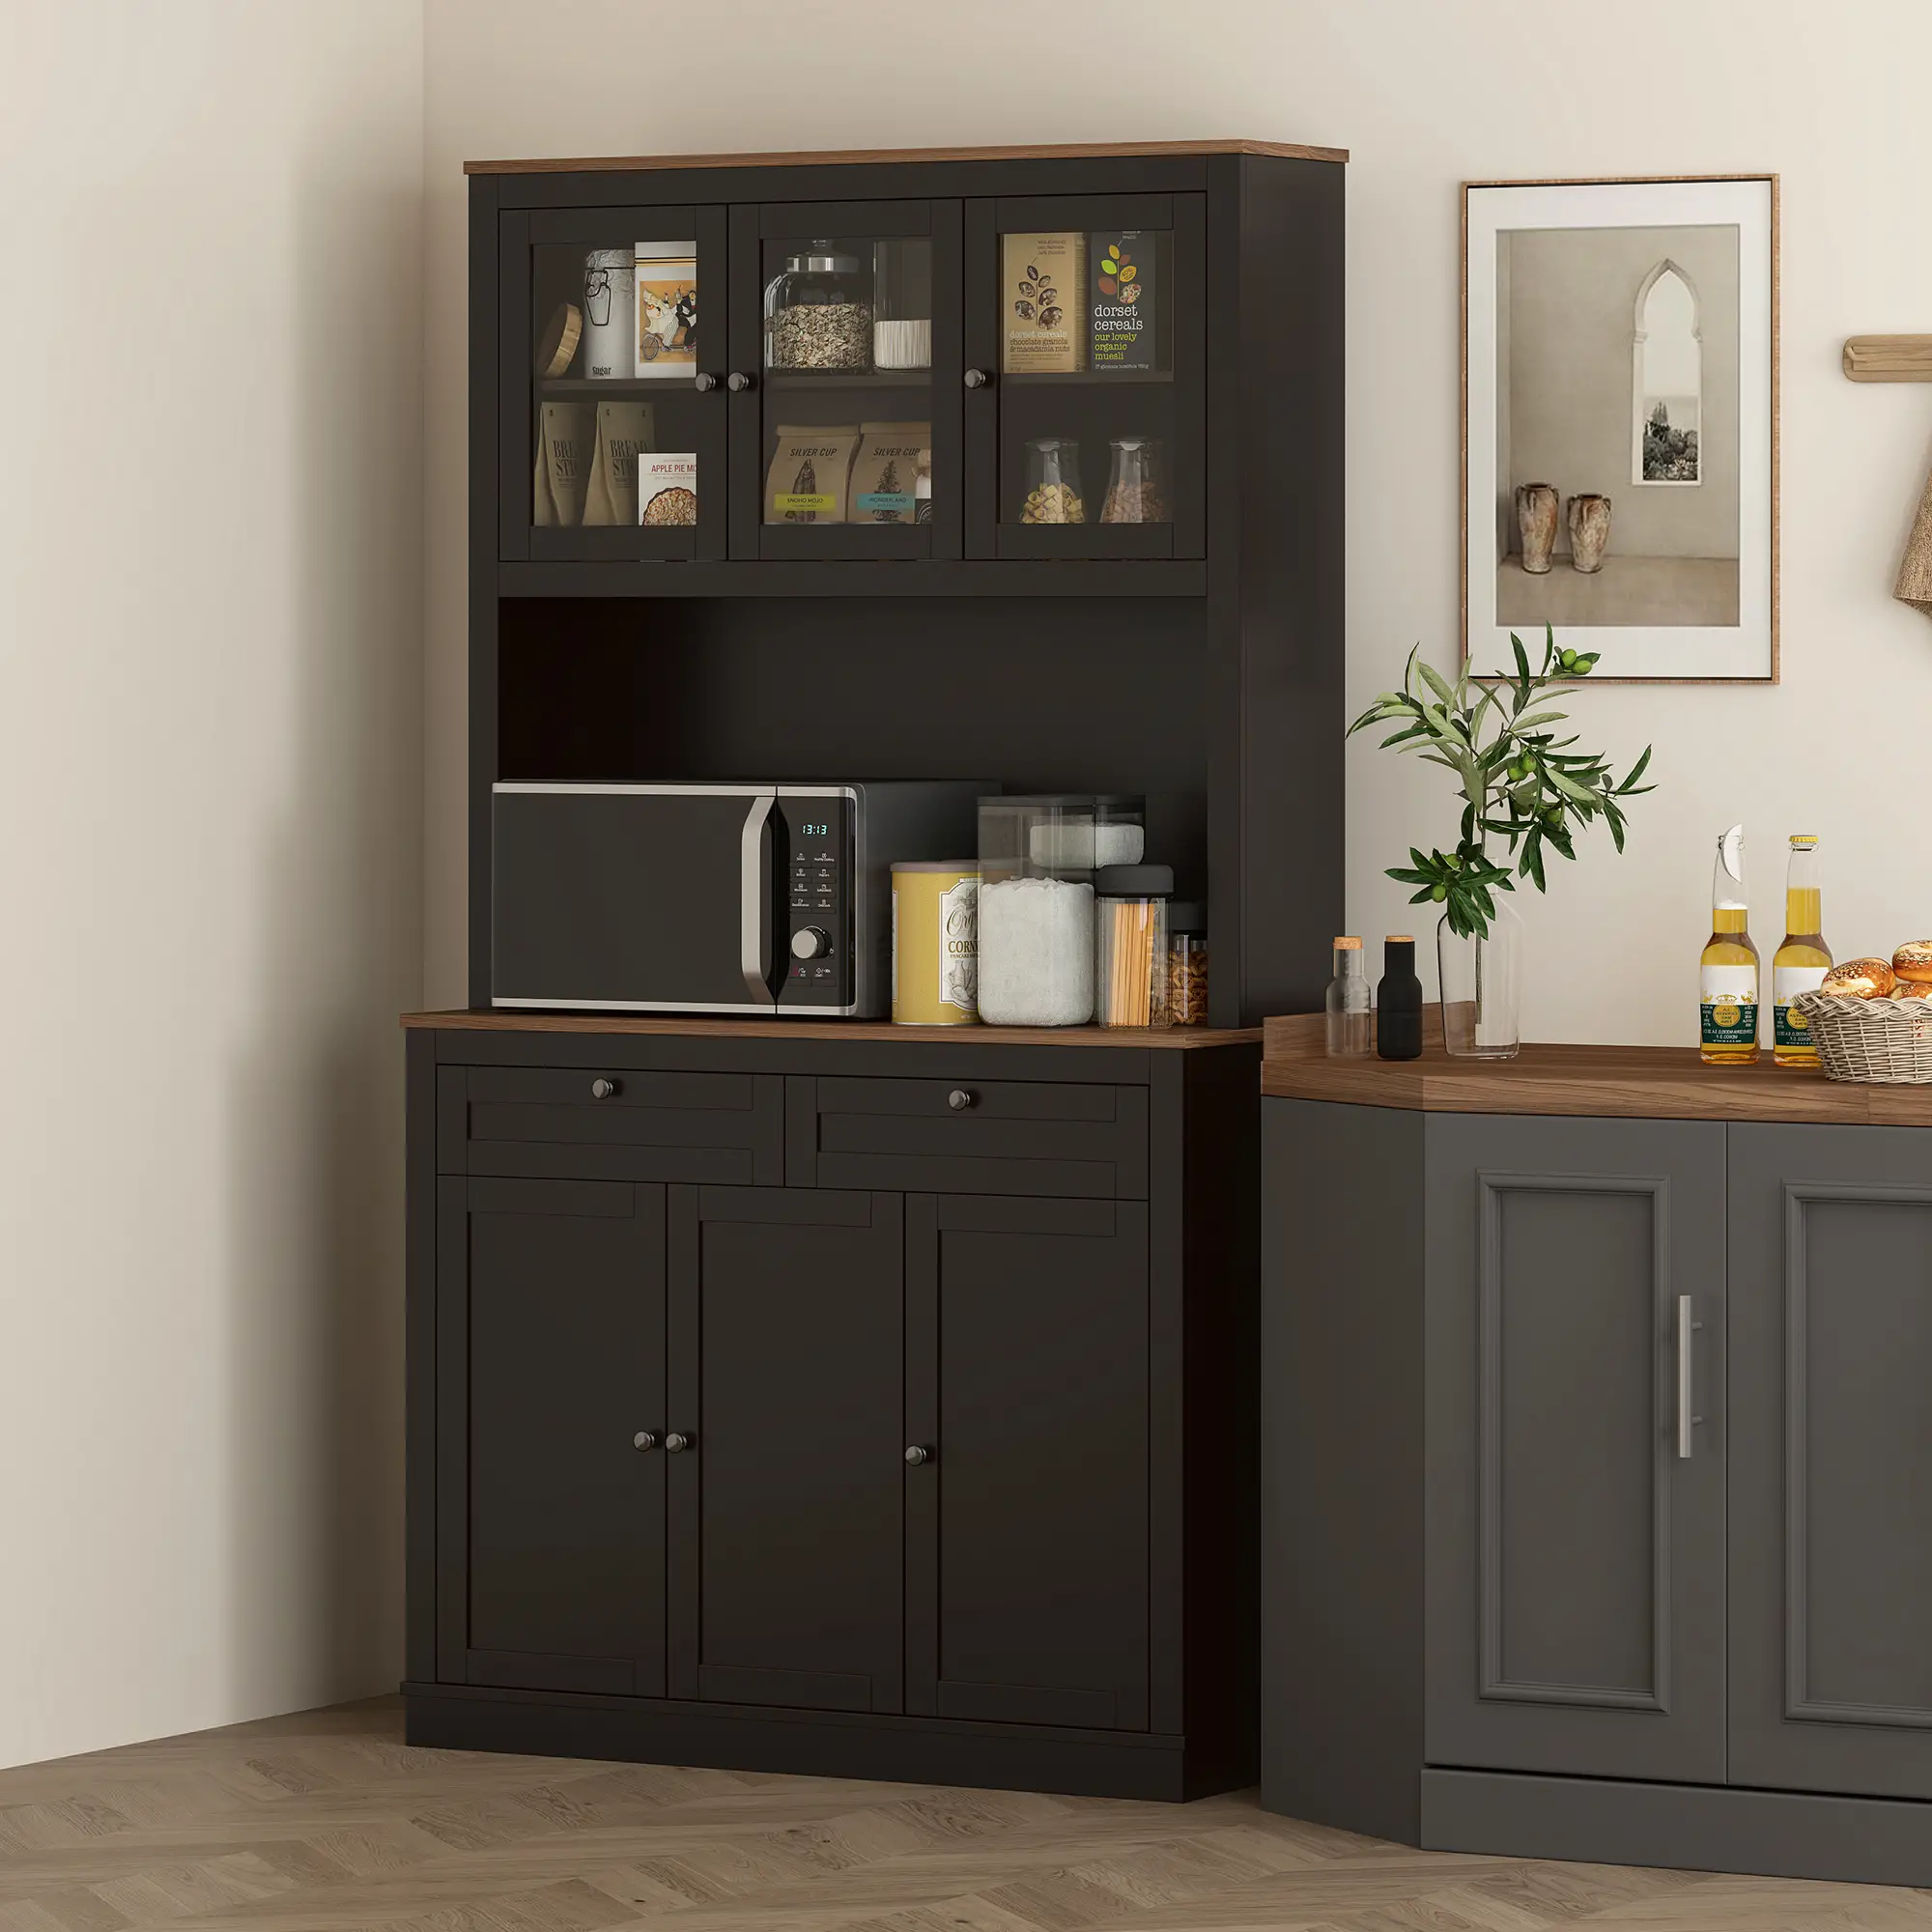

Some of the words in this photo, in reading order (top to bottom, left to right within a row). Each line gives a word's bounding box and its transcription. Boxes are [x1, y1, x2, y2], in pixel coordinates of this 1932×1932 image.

[1094, 304, 1138, 317] dorset
[1094, 318, 1143, 330] cereals
[1037, 329, 1067, 338] cereals
[1112, 332, 1137, 342] lovely
[1043, 338, 1068, 347] granola
[1094, 342, 1127, 352] organic
[1094, 352, 1123, 360] muesli
[592, 366, 611, 376] Sugar
[789, 448, 818, 457] SILVER
[819, 448, 838, 457] CUP
[873, 447, 901, 457] SILVER
[902, 447, 921, 457] CUP
[651, 464, 673, 473] APPLE
[674, 464, 685, 473] PIE
[802, 824, 828, 836] 13:13
